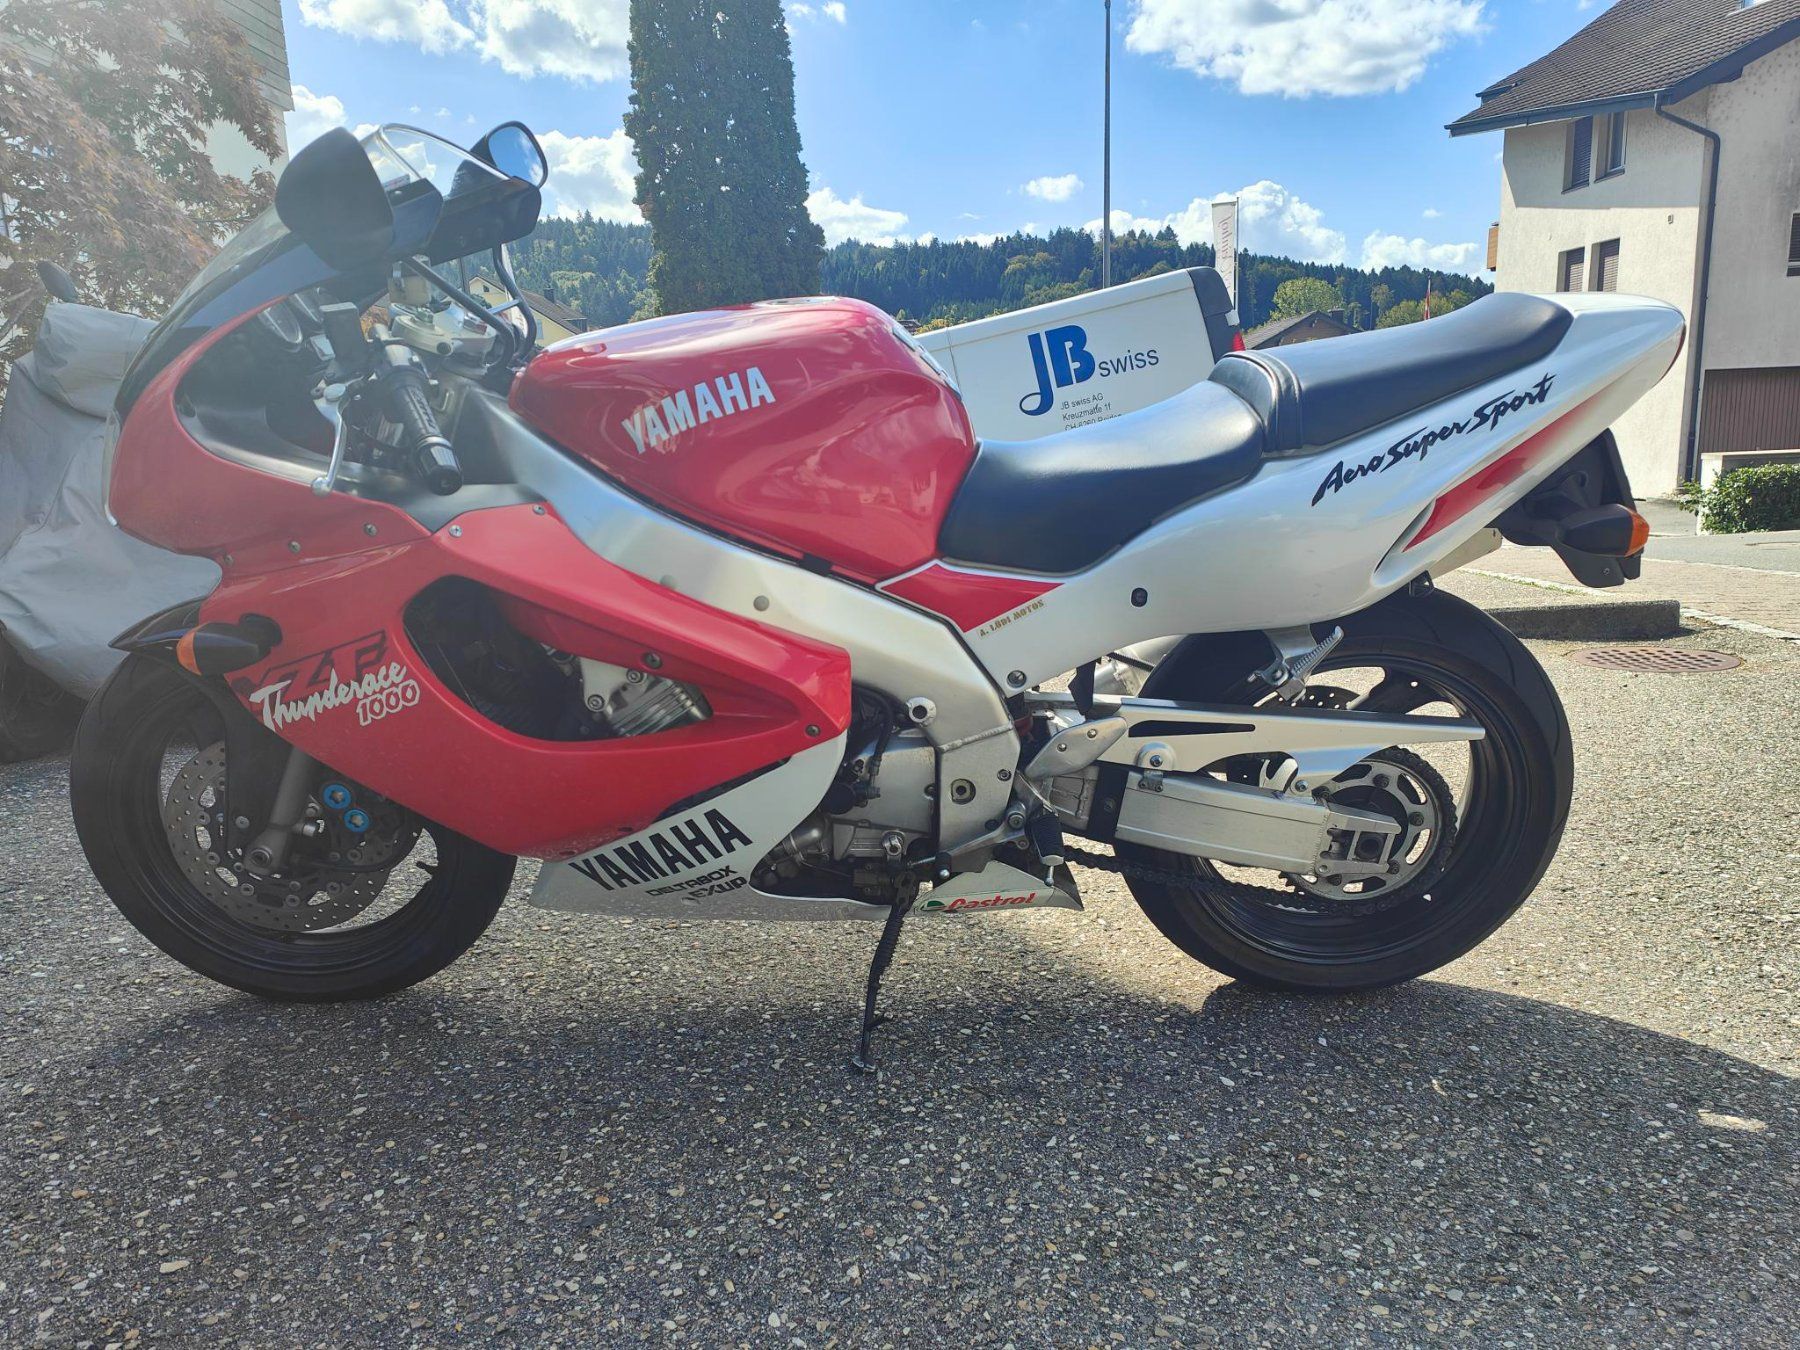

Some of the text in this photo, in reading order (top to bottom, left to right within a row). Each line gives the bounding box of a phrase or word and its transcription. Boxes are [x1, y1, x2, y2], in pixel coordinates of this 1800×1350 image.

[1020, 325, 1160, 416] JB swiss
[621, 366, 776, 455] YAMAHA
[1071, 397, 1091, 407] swiss
[1092, 392, 1104, 402] AG
[249, 661, 407, 732] Thunderace
[356, 678, 420, 727] 1000
[568, 808, 753, 891] YAMAHA
[645, 865, 738, 896] DELTABOX
[687, 876, 748, 898] EXUP
[948, 892, 1036, 911] Castrol
